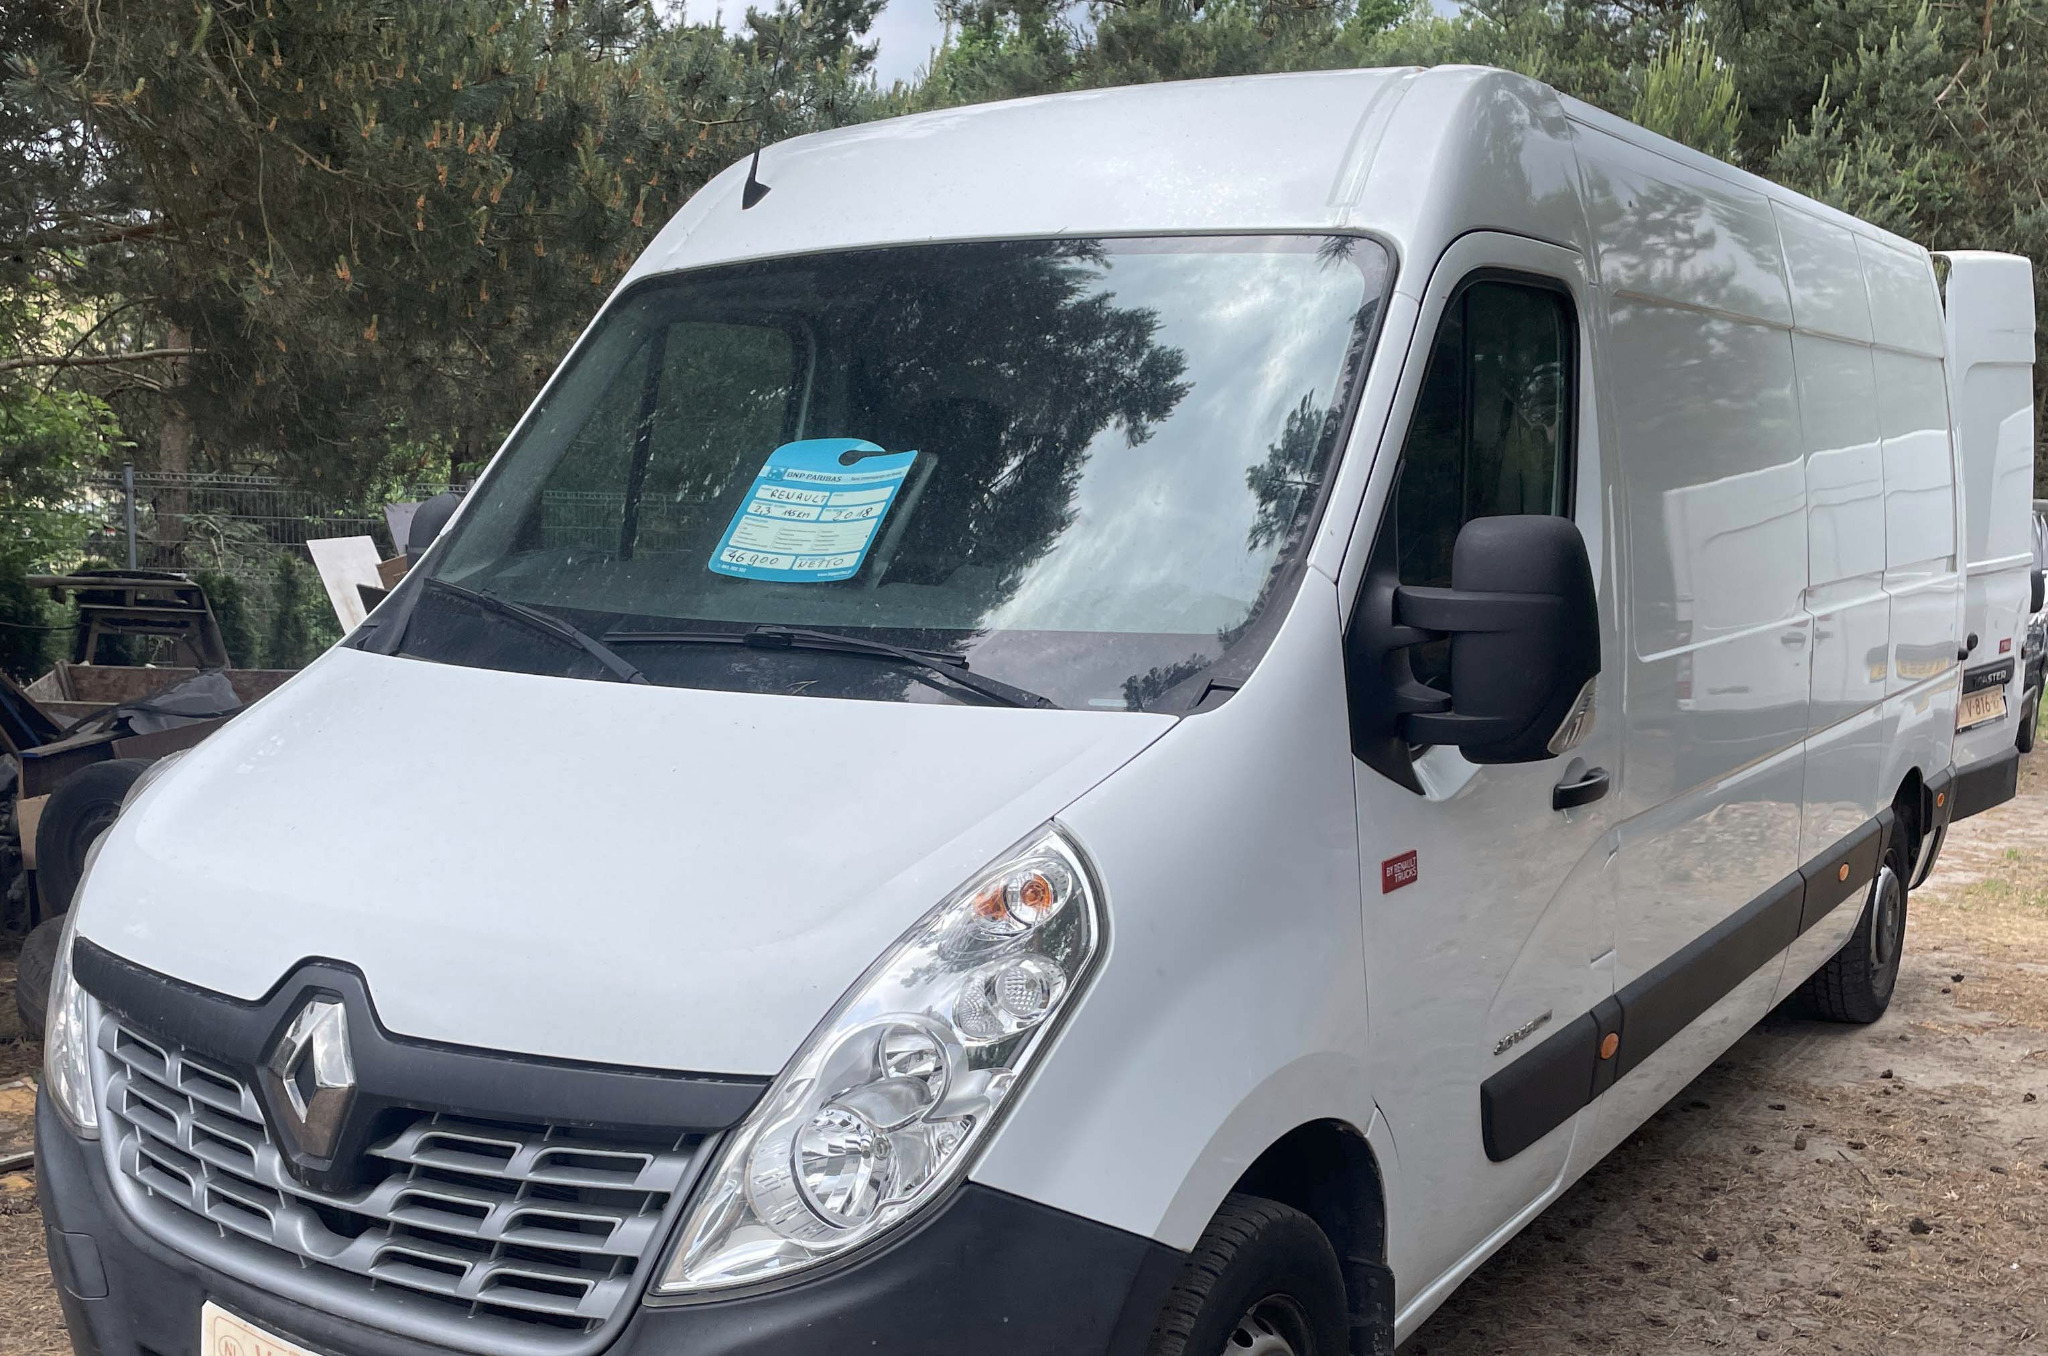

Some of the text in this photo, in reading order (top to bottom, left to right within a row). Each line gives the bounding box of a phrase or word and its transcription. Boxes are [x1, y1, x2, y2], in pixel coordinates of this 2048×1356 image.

[786, 469, 805, 479] BNP
[806, 473, 842, 483] PARIBAS
[770, 489, 828, 503] RENAULT
[754, 505, 771, 516] 2,3
[832, 507, 873, 521] 2018
[797, 557, 844, 568] NETTO
[1386, 856, 1416, 877] BY RENAULT
[1394, 866, 1417, 883] TRUCKS
